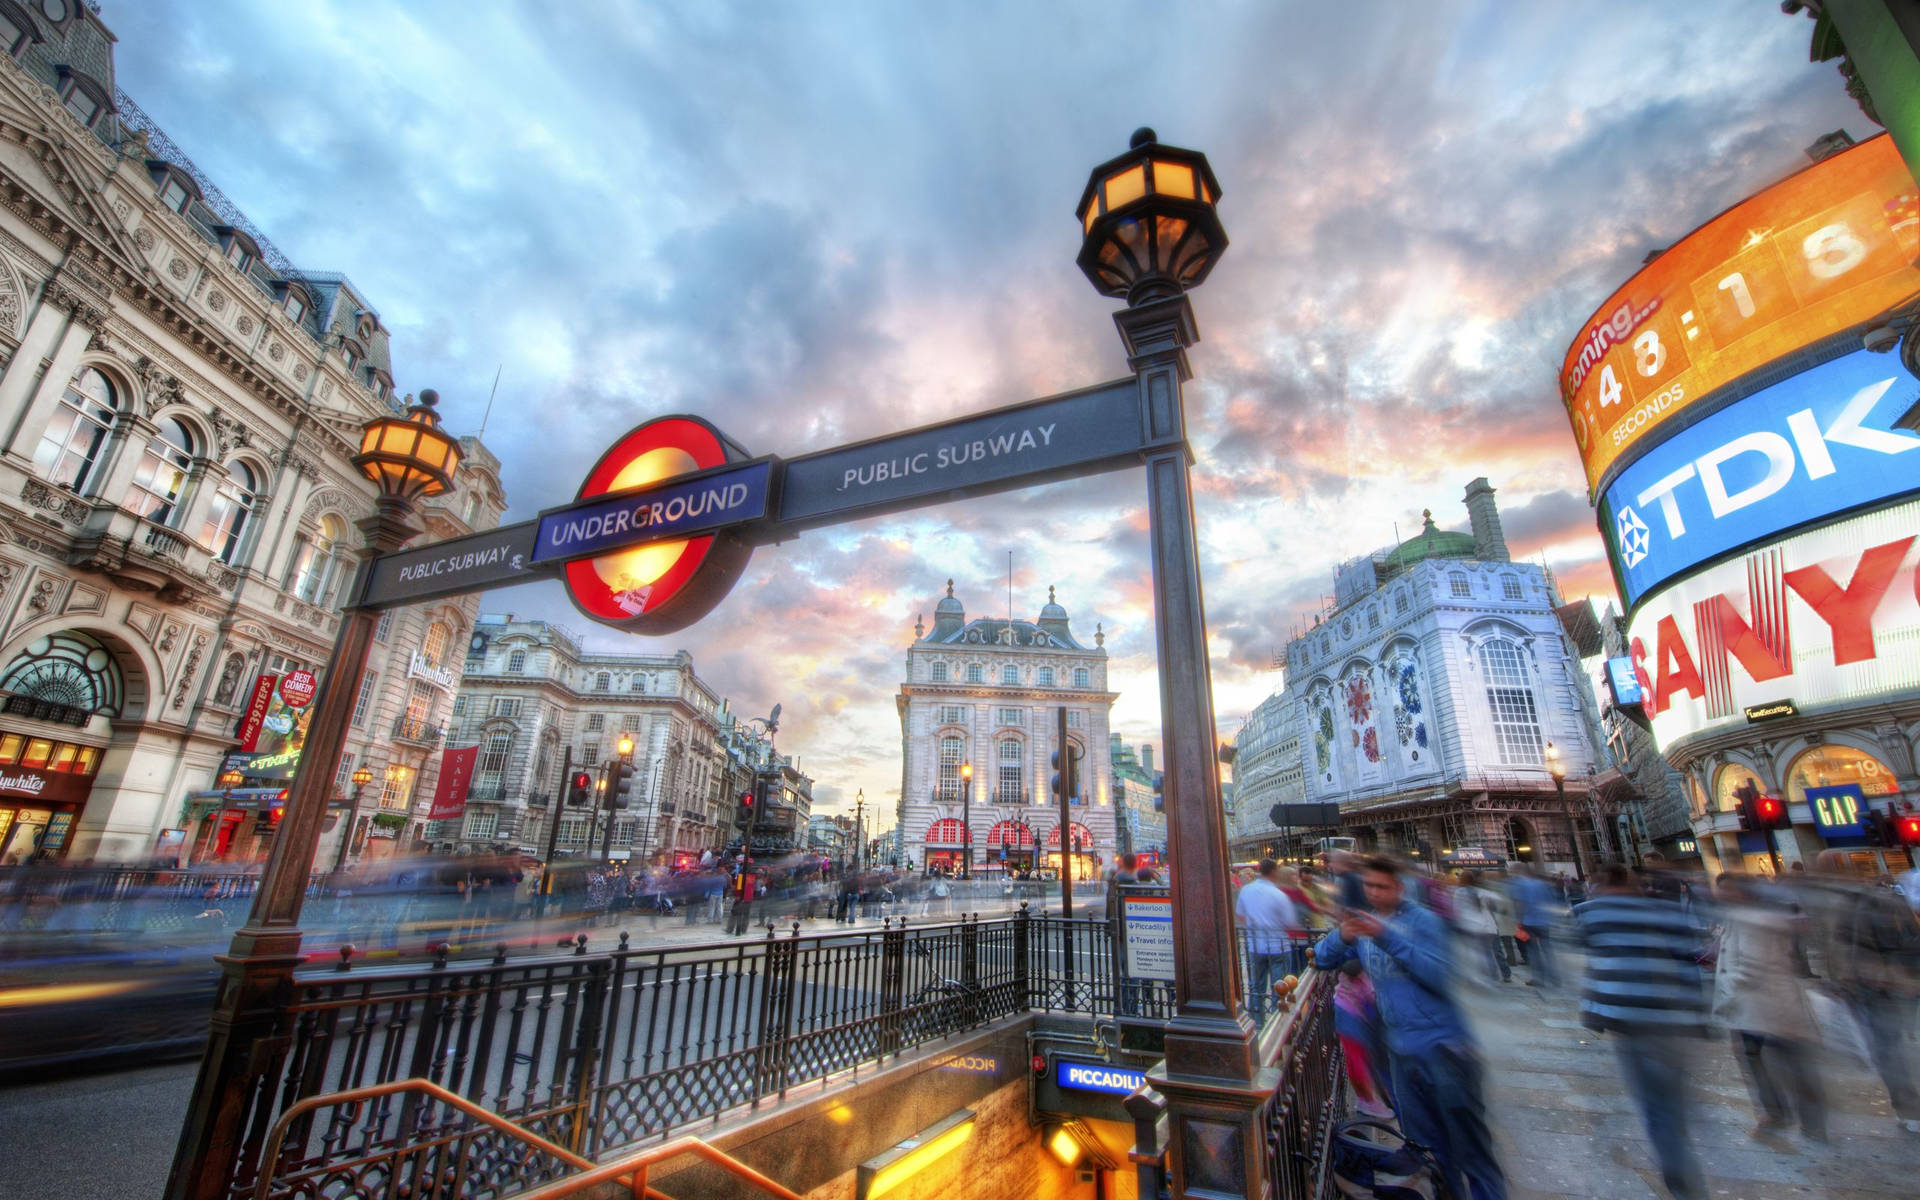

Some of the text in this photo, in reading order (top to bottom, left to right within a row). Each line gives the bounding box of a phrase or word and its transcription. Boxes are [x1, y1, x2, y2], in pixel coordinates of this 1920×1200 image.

[1613, 383, 1684, 445] SECONDS
[844, 423, 1056, 489] PUBLIC SUBWAY
[1637, 377, 1920, 540] TDK
[552, 483, 747, 546] UNDERGROUND
[399, 545, 510, 582] PUBLIC SUBWAY
[1630, 535, 1920, 720] SANY
[285, 680, 314, 695] COMEDY
[294, 672, 311, 685] BEST
[250, 709, 263, 726] 39
[449, 754, 464, 799] SALE
[1816, 796, 1858, 826] GAP
[1679, 841, 1695, 852] GAP
[1134, 904, 1163, 912] Bakerloo
[1135, 923, 1166, 932] Piccadilly
